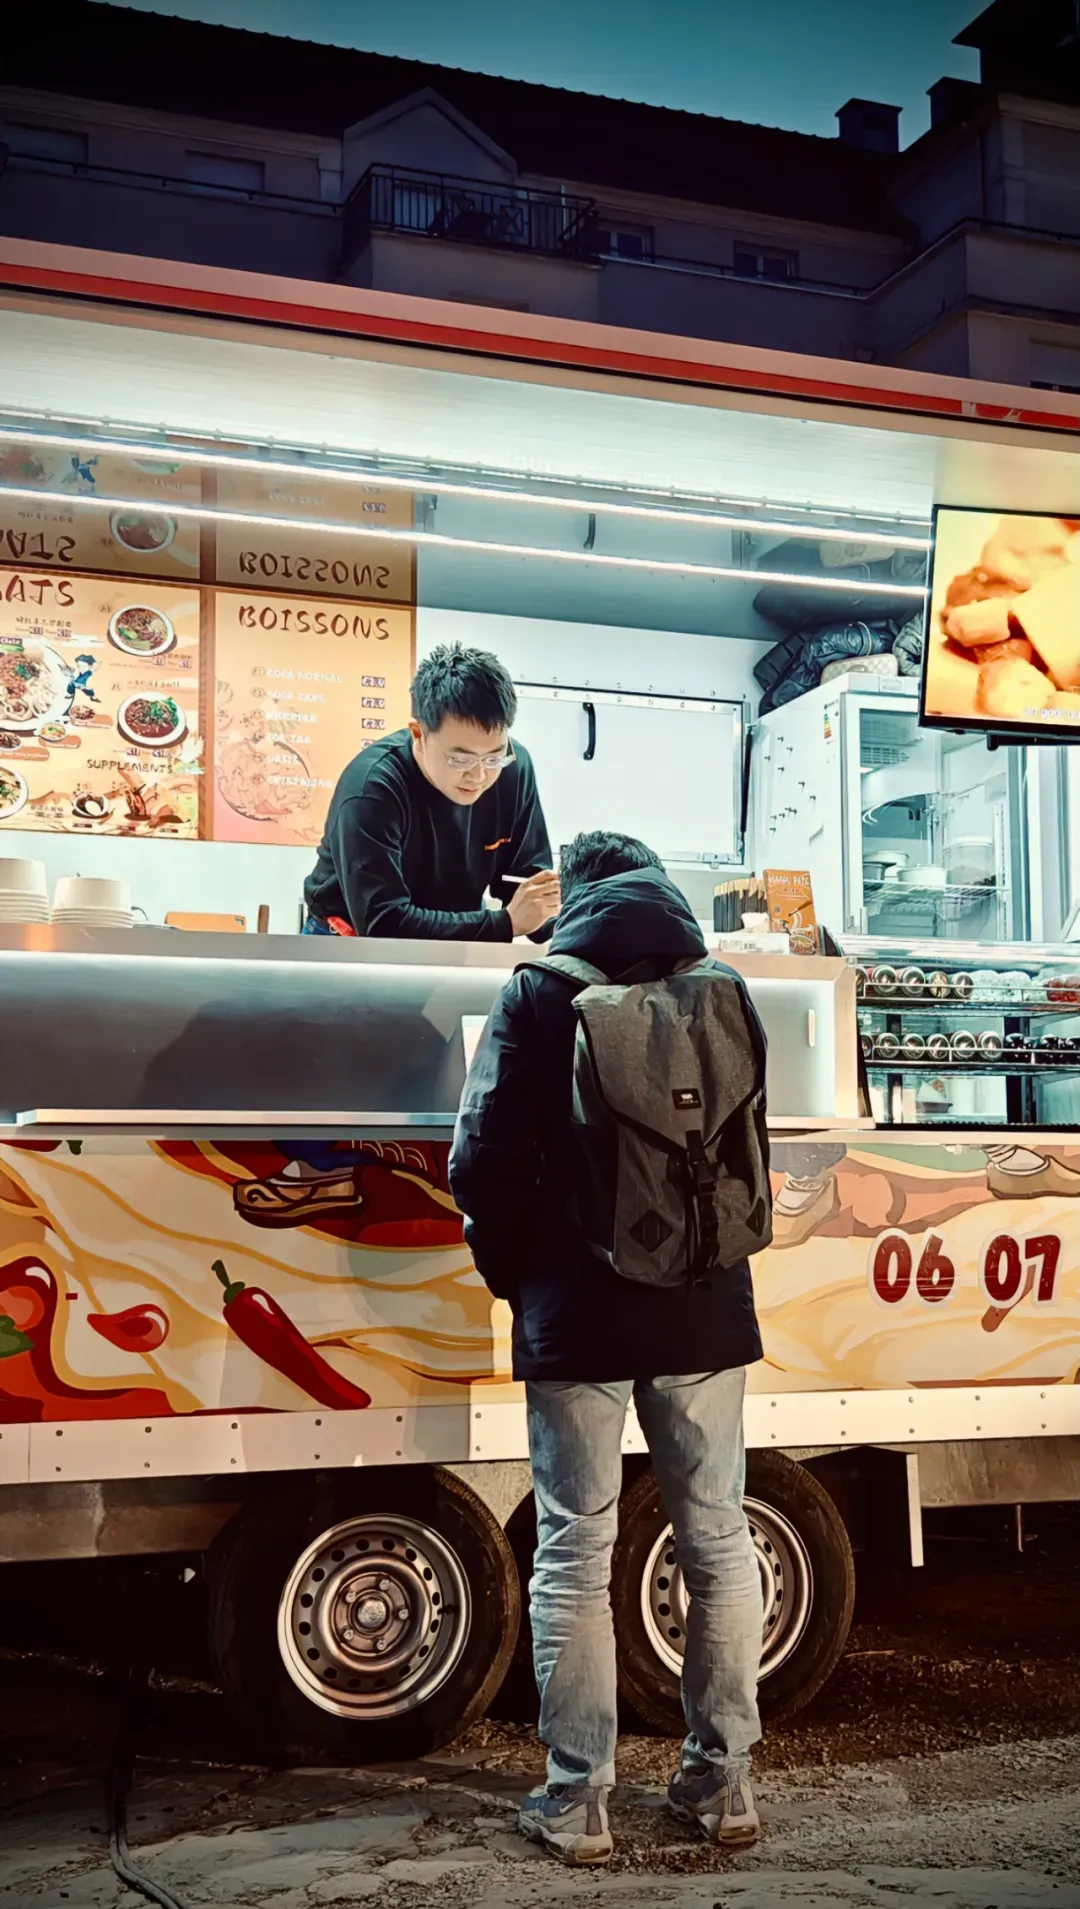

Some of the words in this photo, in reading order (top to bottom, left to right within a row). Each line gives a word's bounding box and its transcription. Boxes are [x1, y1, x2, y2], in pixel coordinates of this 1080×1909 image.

[0, 574, 75, 607] ATS
[238, 605, 389, 640] BOISSONS
[87, 759, 173, 774] SUPPLEMENTS
[873, 1234, 955, 1304] 06
[984, 1234, 1061, 1301] 07
